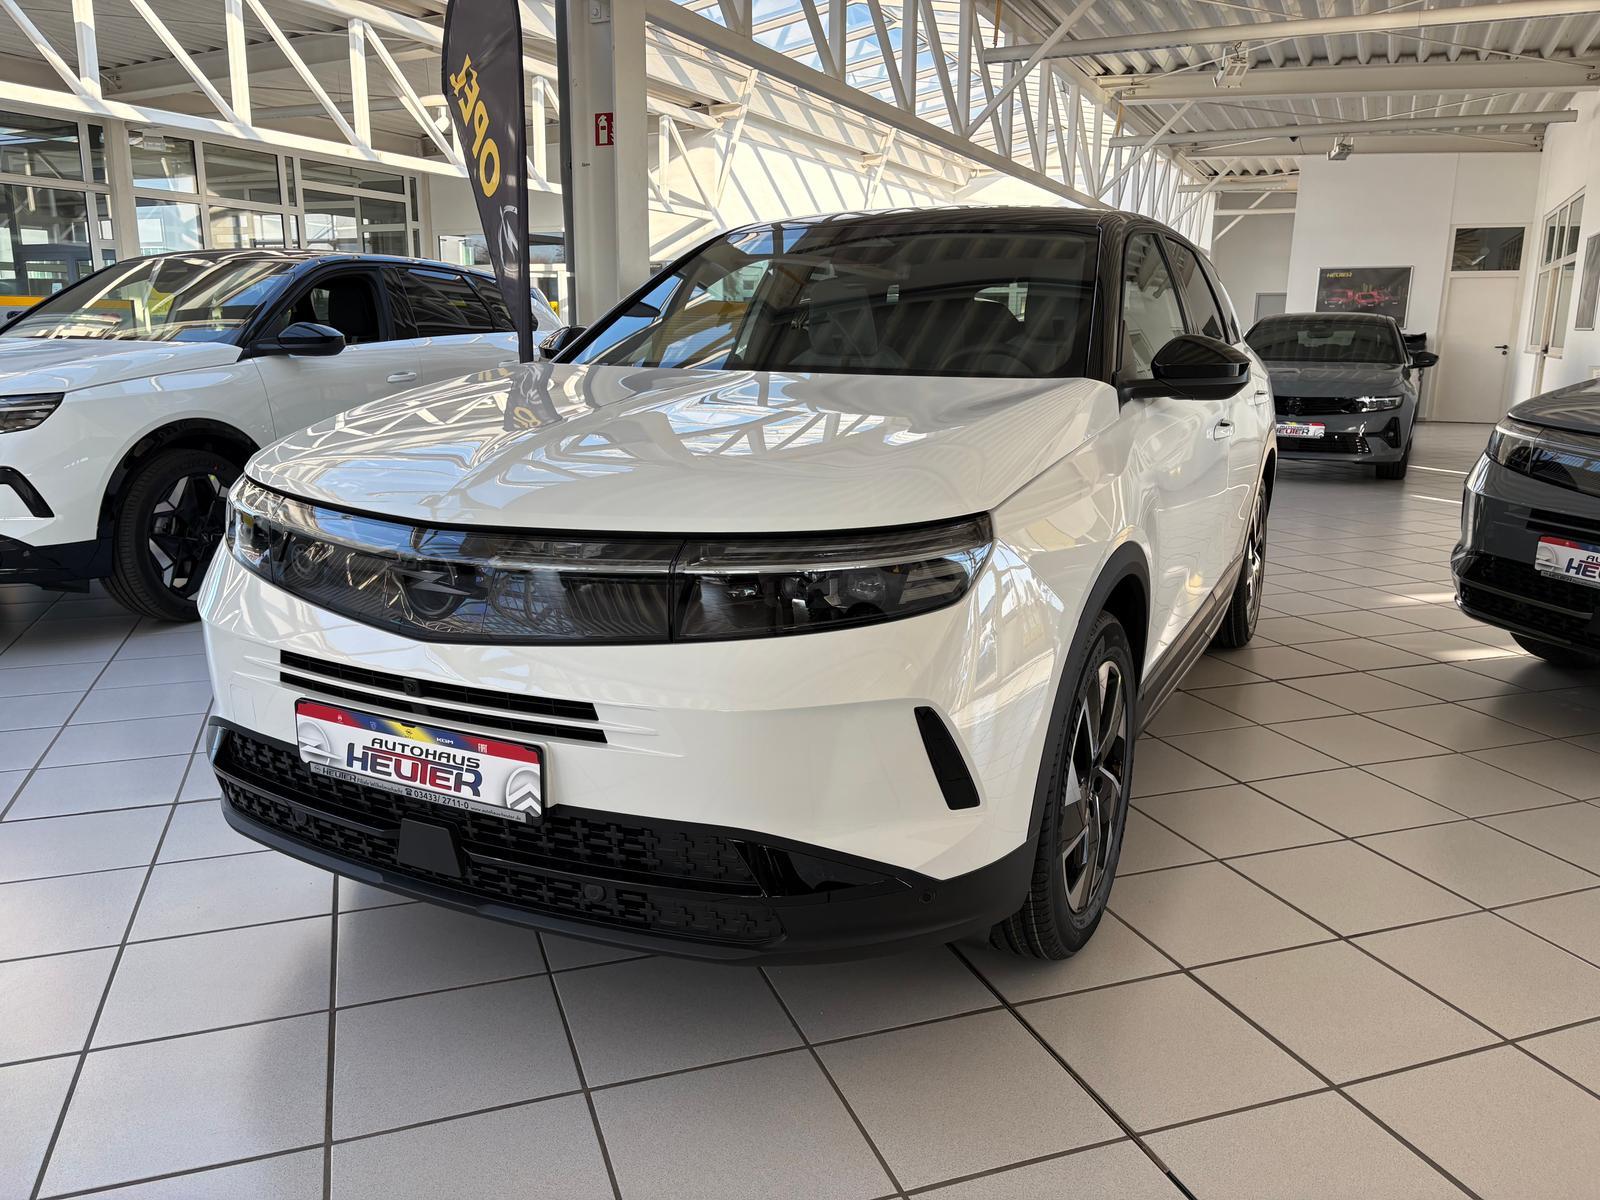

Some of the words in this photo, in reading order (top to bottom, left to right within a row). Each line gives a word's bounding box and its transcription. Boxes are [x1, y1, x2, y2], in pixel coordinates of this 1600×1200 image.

[346, 742, 483, 797] HEUTER
[371, 737, 480, 769] AUTOHAUS
[322, 767, 357, 782] HEUTER
[442, 796, 469, 810] 2711-0
